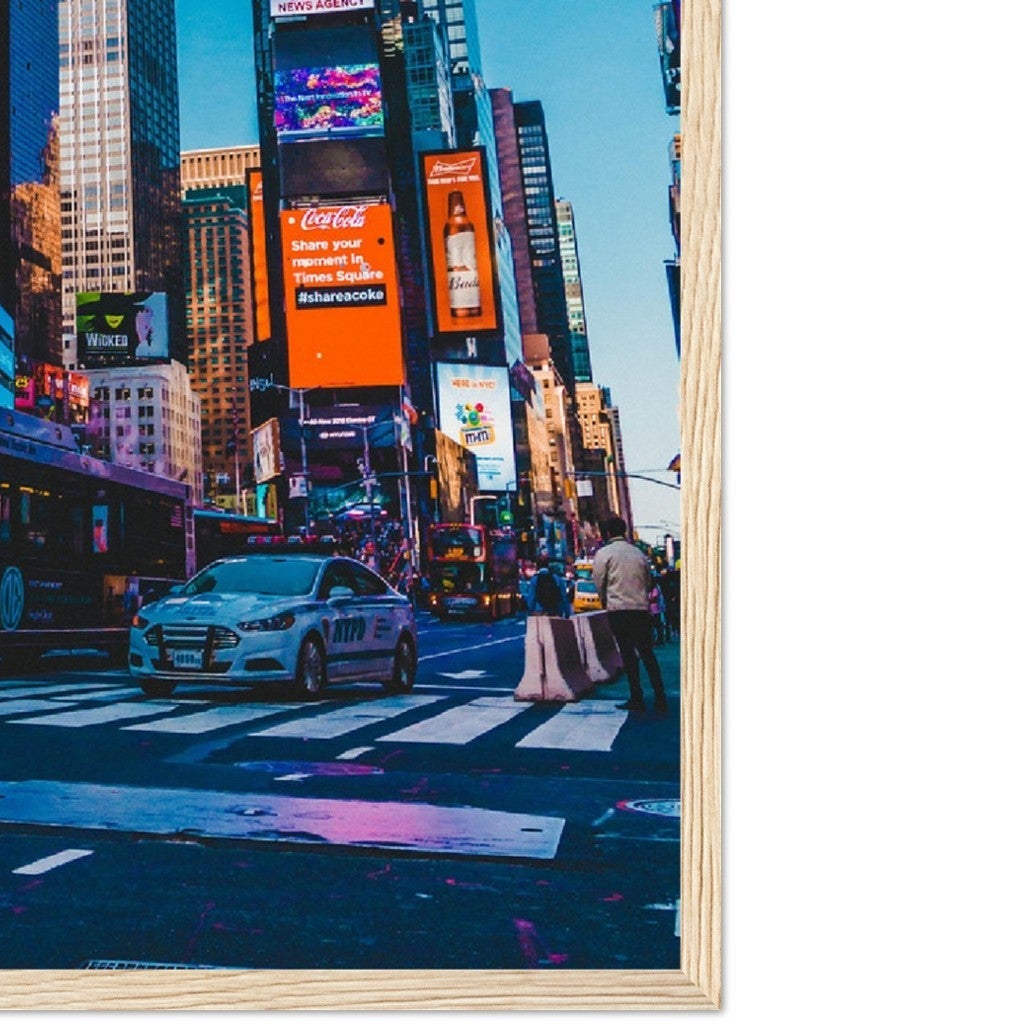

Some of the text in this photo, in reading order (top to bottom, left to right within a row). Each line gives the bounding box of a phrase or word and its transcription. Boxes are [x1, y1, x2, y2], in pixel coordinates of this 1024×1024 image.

[278, 0, 312, 13] NEWS
[301, 205, 368, 230] Coca-Cola
[291, 239, 363, 252] Share your
[292, 254, 348, 268] moment
[293, 270, 384, 284] Times Square
[297, 288, 385, 304] #shareacoke
[332, 616, 366, 644] NYPD
